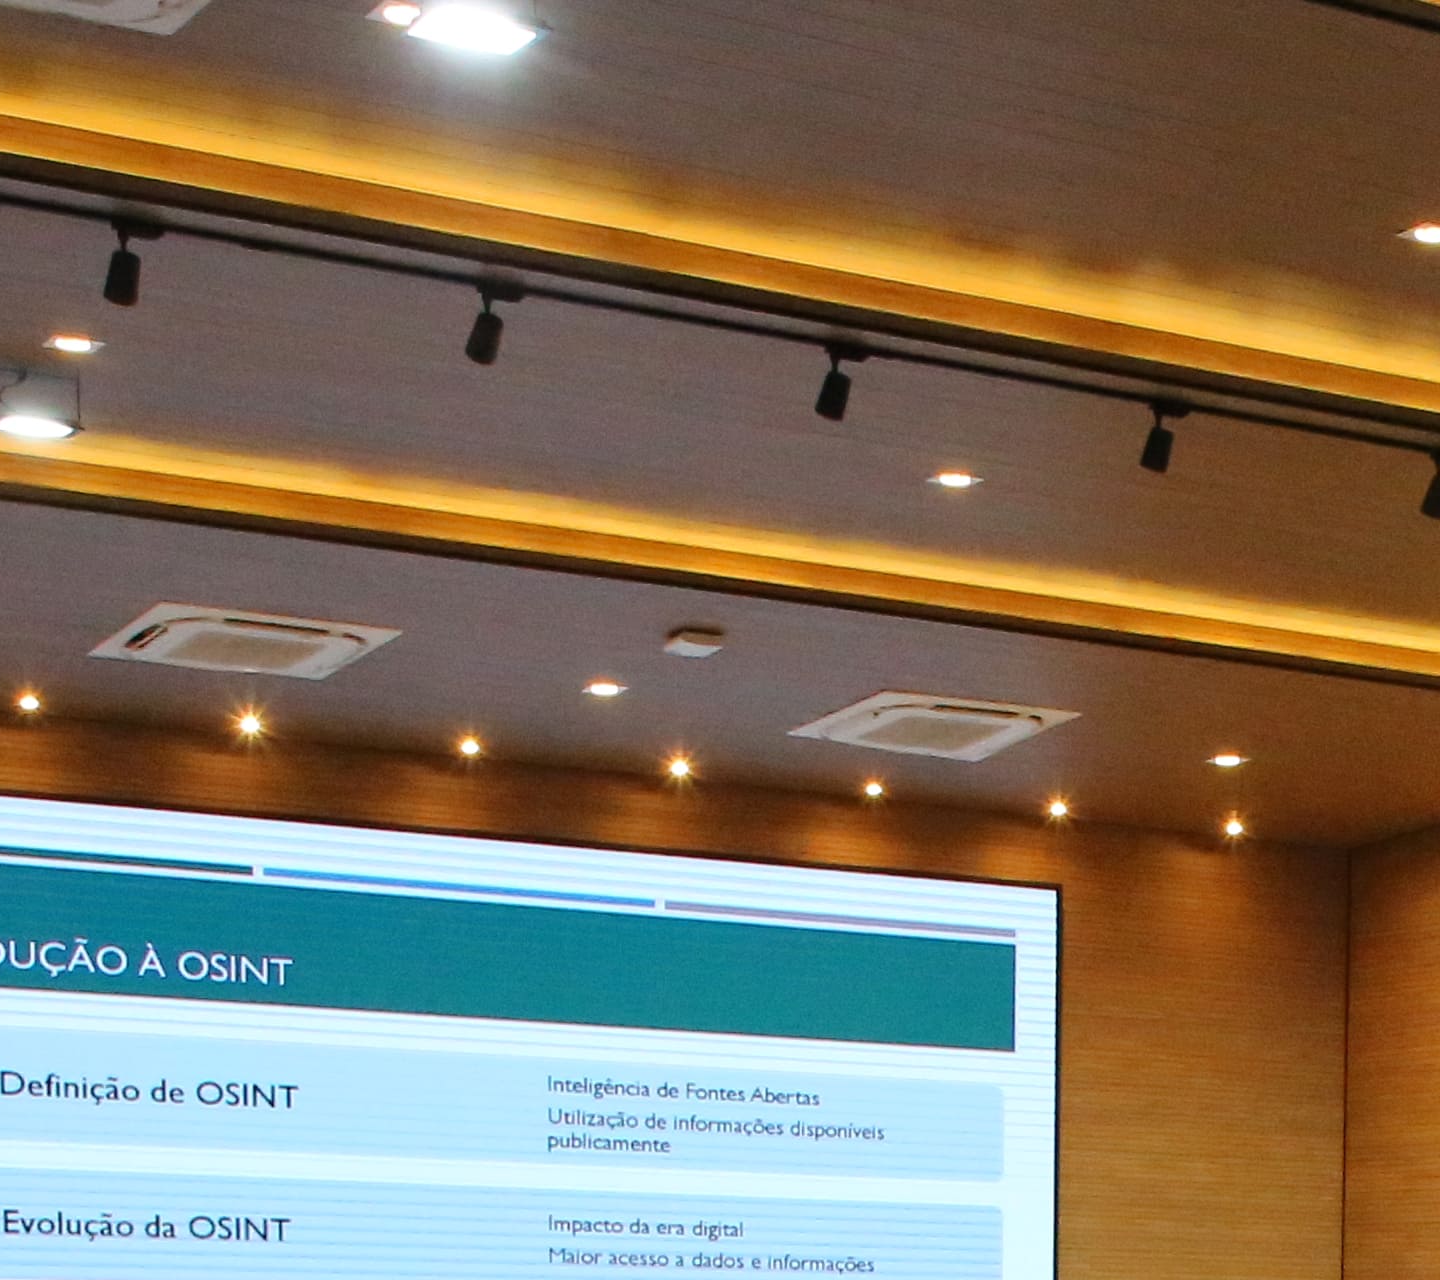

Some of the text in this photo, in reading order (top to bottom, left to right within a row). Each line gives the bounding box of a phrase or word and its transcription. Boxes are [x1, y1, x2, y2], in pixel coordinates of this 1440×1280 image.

[139, 943, 166, 978] À
[178, 950, 294, 986] OSINT
[0, 1070, 299, 1109] Definição de OSINT
[547, 1075, 821, 1106] Inteligência de Fontes Abertas
[547, 1108, 639, 1130] Utilização
[645, 1113, 667, 1130] de
[673, 1114, 784, 1136] informações
[547, 1132, 671, 1153] publicamente
[3, 1209, 291, 1242] Evolução da OSINT
[548, 1214, 744, 1242] Impacto da era digital
[548, 1248, 875, 1275] Maior acesso a dados e informações
